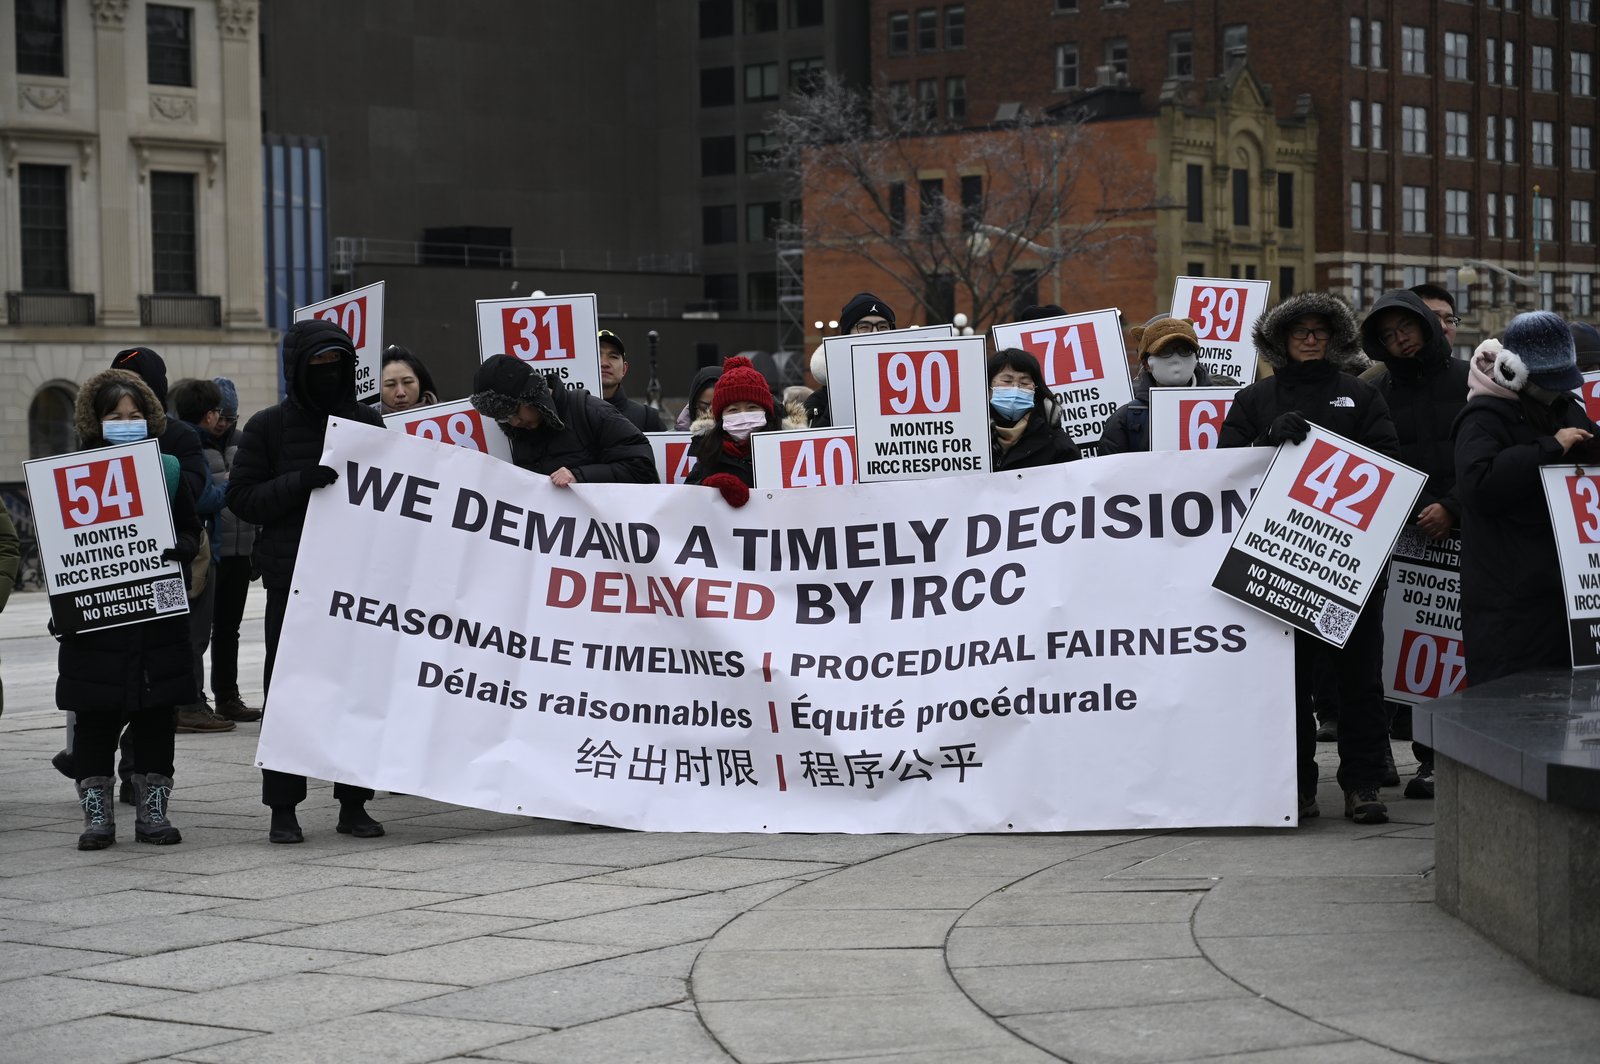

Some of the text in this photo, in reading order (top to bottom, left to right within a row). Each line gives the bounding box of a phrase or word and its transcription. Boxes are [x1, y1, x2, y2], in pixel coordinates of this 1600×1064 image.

[512, 306, 567, 361] 31
[1194, 287, 1239, 340] 39
[1031, 325, 1094, 385] 71
[1198, 346, 1232, 361] ONTHS
[1220, 364, 1242, 377] FOR
[886, 351, 951, 414] 90
[1055, 387, 1100, 405] ONTHS
[890, 420, 954, 437] MONTHS
[1090, 402, 1117, 417] FOR
[1189, 400, 1233, 450] 6
[790, 438, 854, 488] 40
[867, 456, 982, 475] IRCC RESPONSE
[875, 438, 972, 456] WAITING FOR
[64, 458, 133, 525] 54
[1303, 449, 1381, 526] 42
[1576, 477, 1600, 542] 3
[73, 524, 138, 547] MONTHS
[345, 461, 1258, 572] WE DEMAND A TIMELY DECISION
[1286, 508, 1353, 547] MONTHS
[60, 538, 158, 568] WAITING FOR
[1244, 532, 1362, 596] IRCC RESPONSE
[1263, 518, 1361, 574] WAITING FOR
[55, 555, 170, 587] IRCC RESPONSE
[545, 563, 1027, 624] DELAYED BY IRCC
[1247, 563, 1326, 608] NO TIMELINE
[74, 594, 92, 608] NO
[82, 597, 156, 621] NO RESULTS
[1245, 580, 1320, 623] NO RESULTS
[1403, 588, 1432, 607] FOR
[1415, 609, 1462, 631] ONTHS
[328, 590, 574, 666] REASONABLE
[582, 643, 745, 678] TIMELINES
[790, 634, 1035, 681] PROCEDURAL
[1046, 624, 1247, 659] FAIRNESS
[1404, 634, 1466, 698] 40
[417, 661, 527, 710] Délais
[538, 691, 752, 729] raisonnables
[790, 693, 905, 736] Équité
[916, 683, 1137, 733] procédurale
[575, 737, 758, 787] 给出时限
[799, 743, 983, 789] 程序公平
